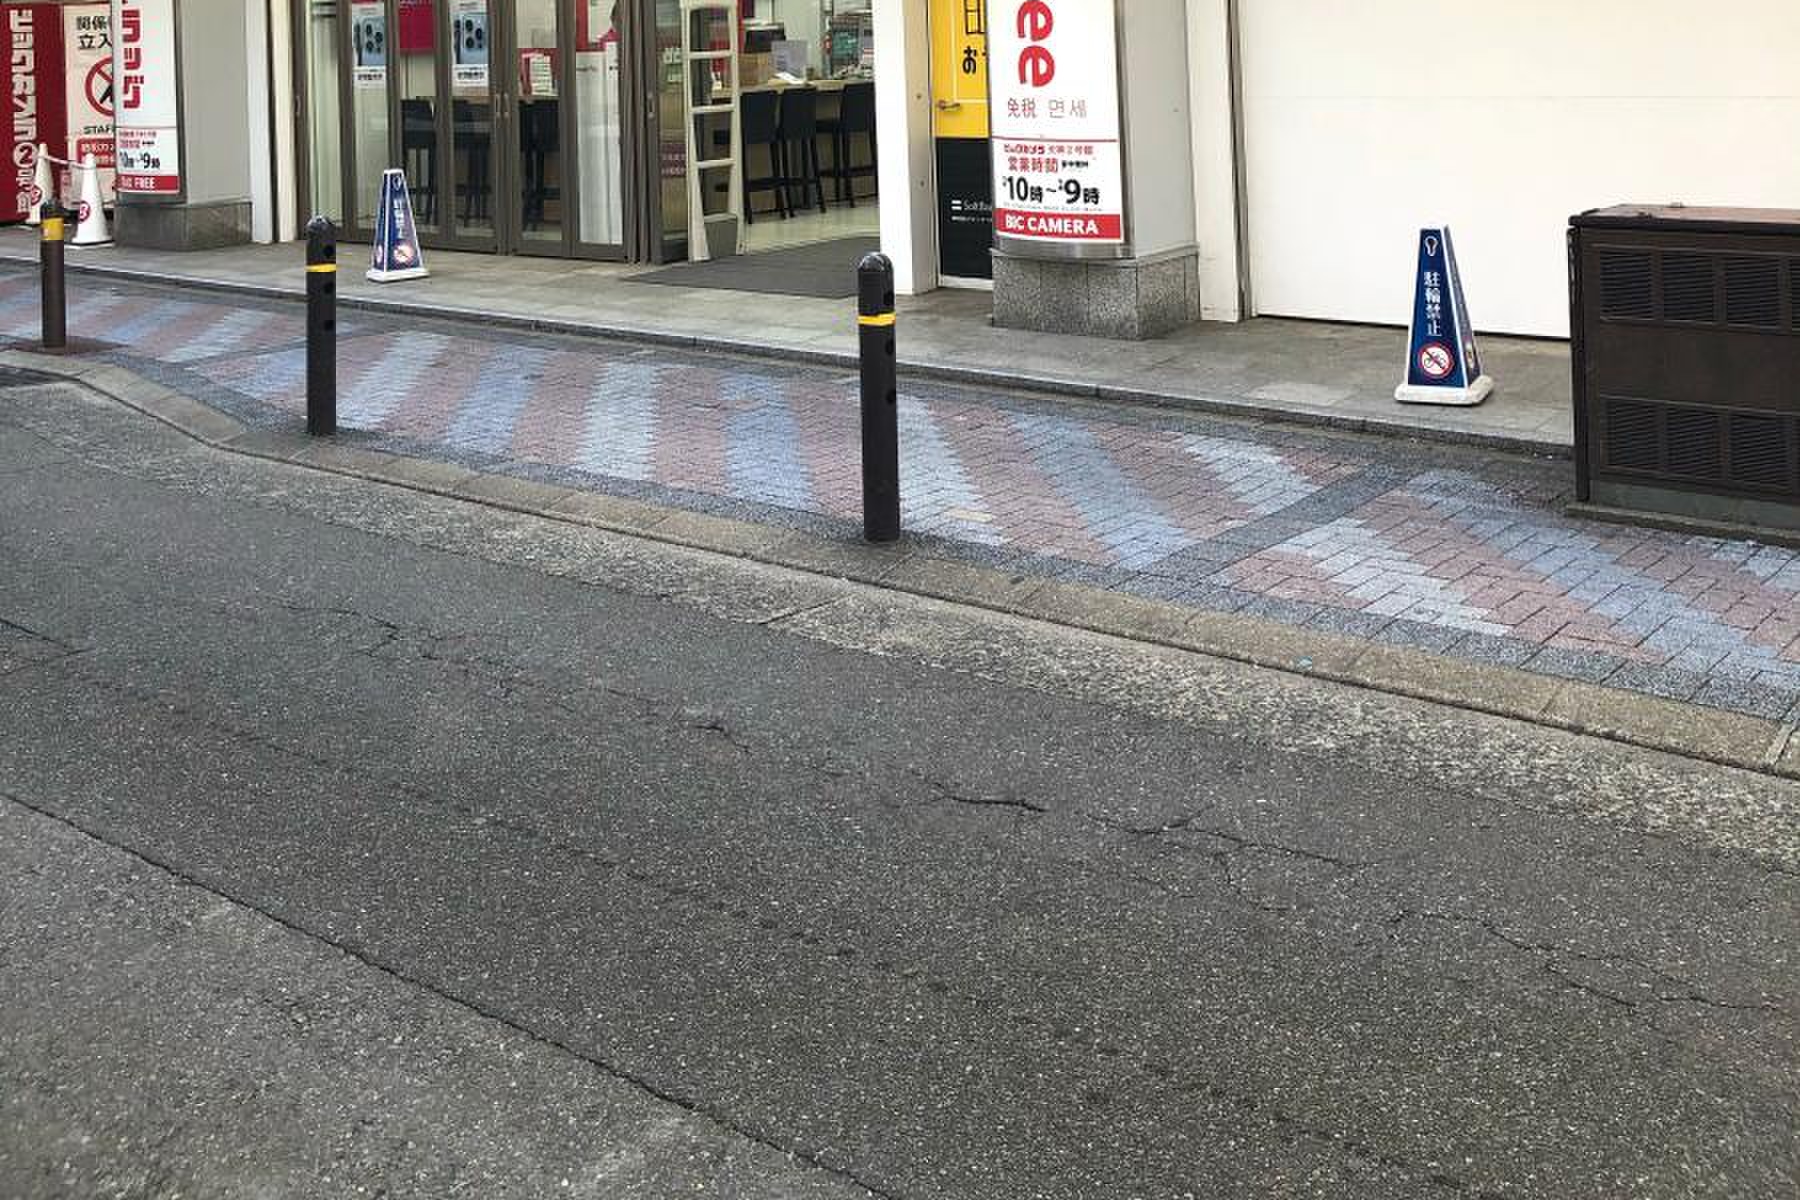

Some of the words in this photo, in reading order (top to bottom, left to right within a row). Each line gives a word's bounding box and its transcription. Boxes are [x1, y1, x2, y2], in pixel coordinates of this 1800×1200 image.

[1007, 156, 1058, 173] 営業時間
[1027, 216, 1099, 235] CAMERA
[1423, 271, 1442, 337] 駐輪禁止
